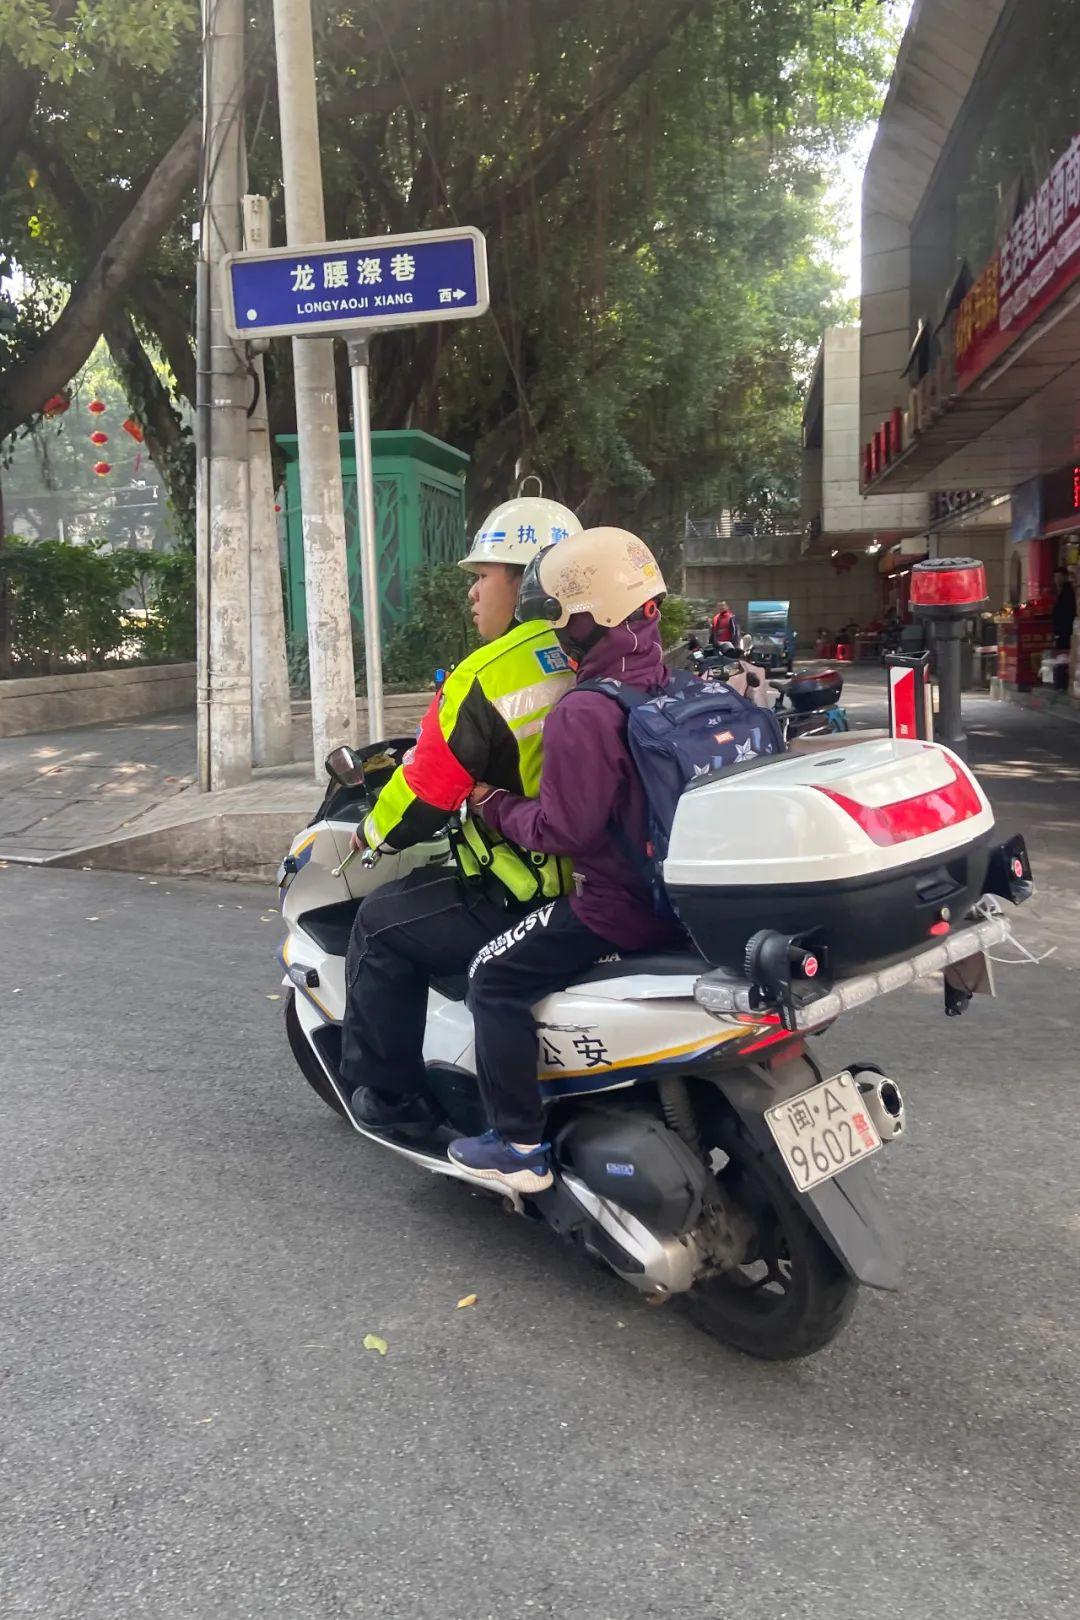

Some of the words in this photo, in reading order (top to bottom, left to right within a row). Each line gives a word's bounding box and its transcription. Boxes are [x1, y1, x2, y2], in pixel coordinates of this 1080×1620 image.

[297, 297, 368, 314] LONGYAOJI
[374, 292, 413, 307] XIANG
[438, 288, 452, 303] 西
[543, 1034, 612, 1068] 公安
[787, 1088, 847, 1137] 闽·A
